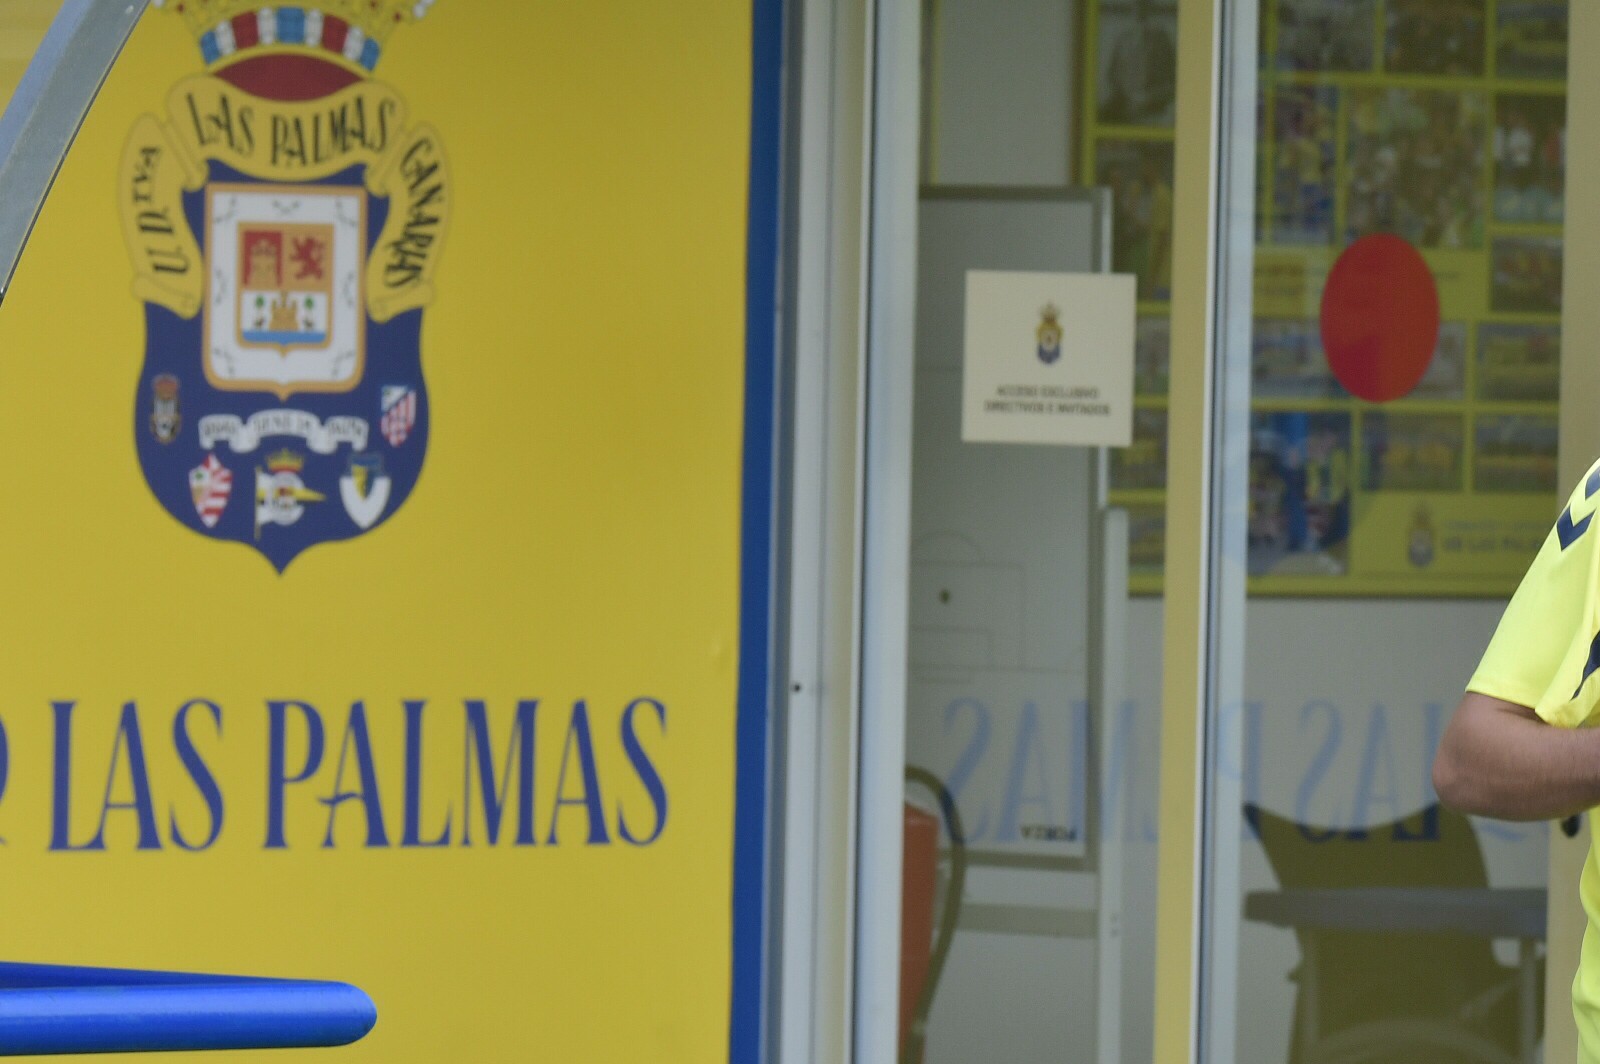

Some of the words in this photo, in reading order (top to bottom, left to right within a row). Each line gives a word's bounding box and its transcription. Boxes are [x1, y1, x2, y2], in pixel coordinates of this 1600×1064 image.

[187, 93, 254, 155] LAS
[270, 96, 394, 167] PALMAS
[47, 698, 224, 852] LAS
[263, 697, 668, 848] PALMAS
